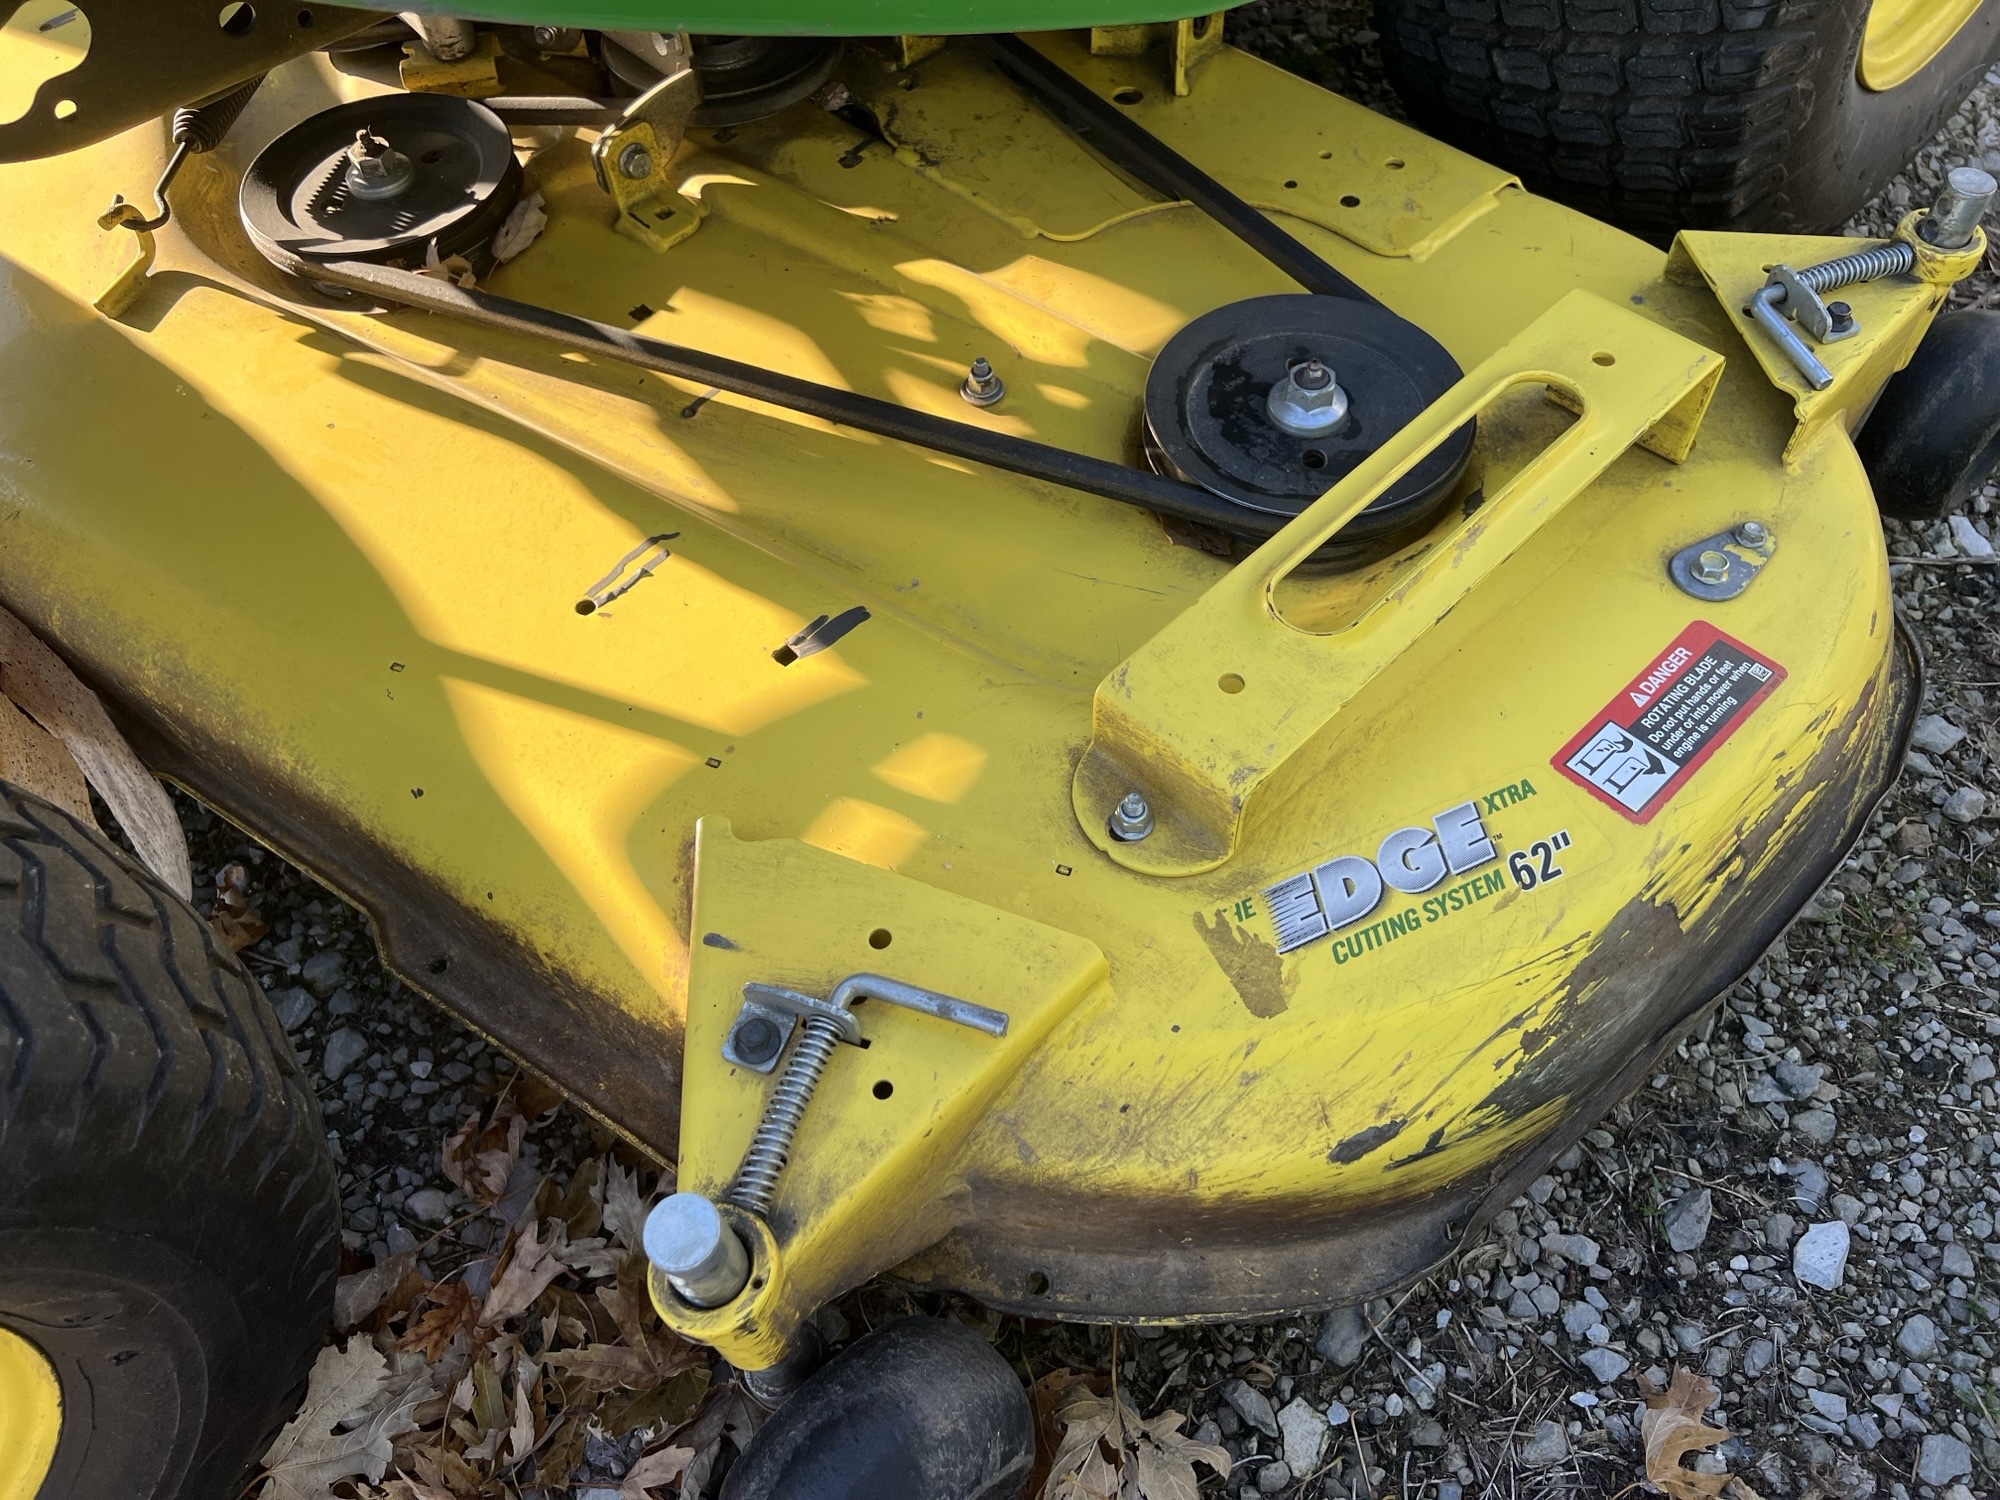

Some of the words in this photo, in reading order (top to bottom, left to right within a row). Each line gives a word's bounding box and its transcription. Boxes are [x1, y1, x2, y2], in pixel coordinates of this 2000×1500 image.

[1639, 647, 1693, 694] DANGER
[1641, 684, 1690, 729] ROTATING
[1683, 655, 1718, 686] BLADE
[1648, 730, 1664, 743] Do
[1662, 716, 1678, 732] not
[1674, 705, 1691, 721] put
[1685, 682, 1712, 708] hands
[1709, 675, 1720, 685] or
[1715, 660, 1734, 676] feet
[1661, 726, 1686, 751] under
[1683, 718, 1695, 729] or
[1689, 704, 1709, 720] into
[1706, 680, 1733, 706] mower
[1729, 661, 1751, 682] when
[1673, 731, 1701, 758] engine
[1695, 723, 1708, 733] is
[1705, 696, 1738, 725] running
[1260, 800, 1498, 954] EDGE
[1482, 779, 1537, 815] XTRA
[1331, 907, 1422, 965] CUTTING
[1426, 869, 1506, 924] SYSTEM
[1508, 830, 1571, 891] 62"
